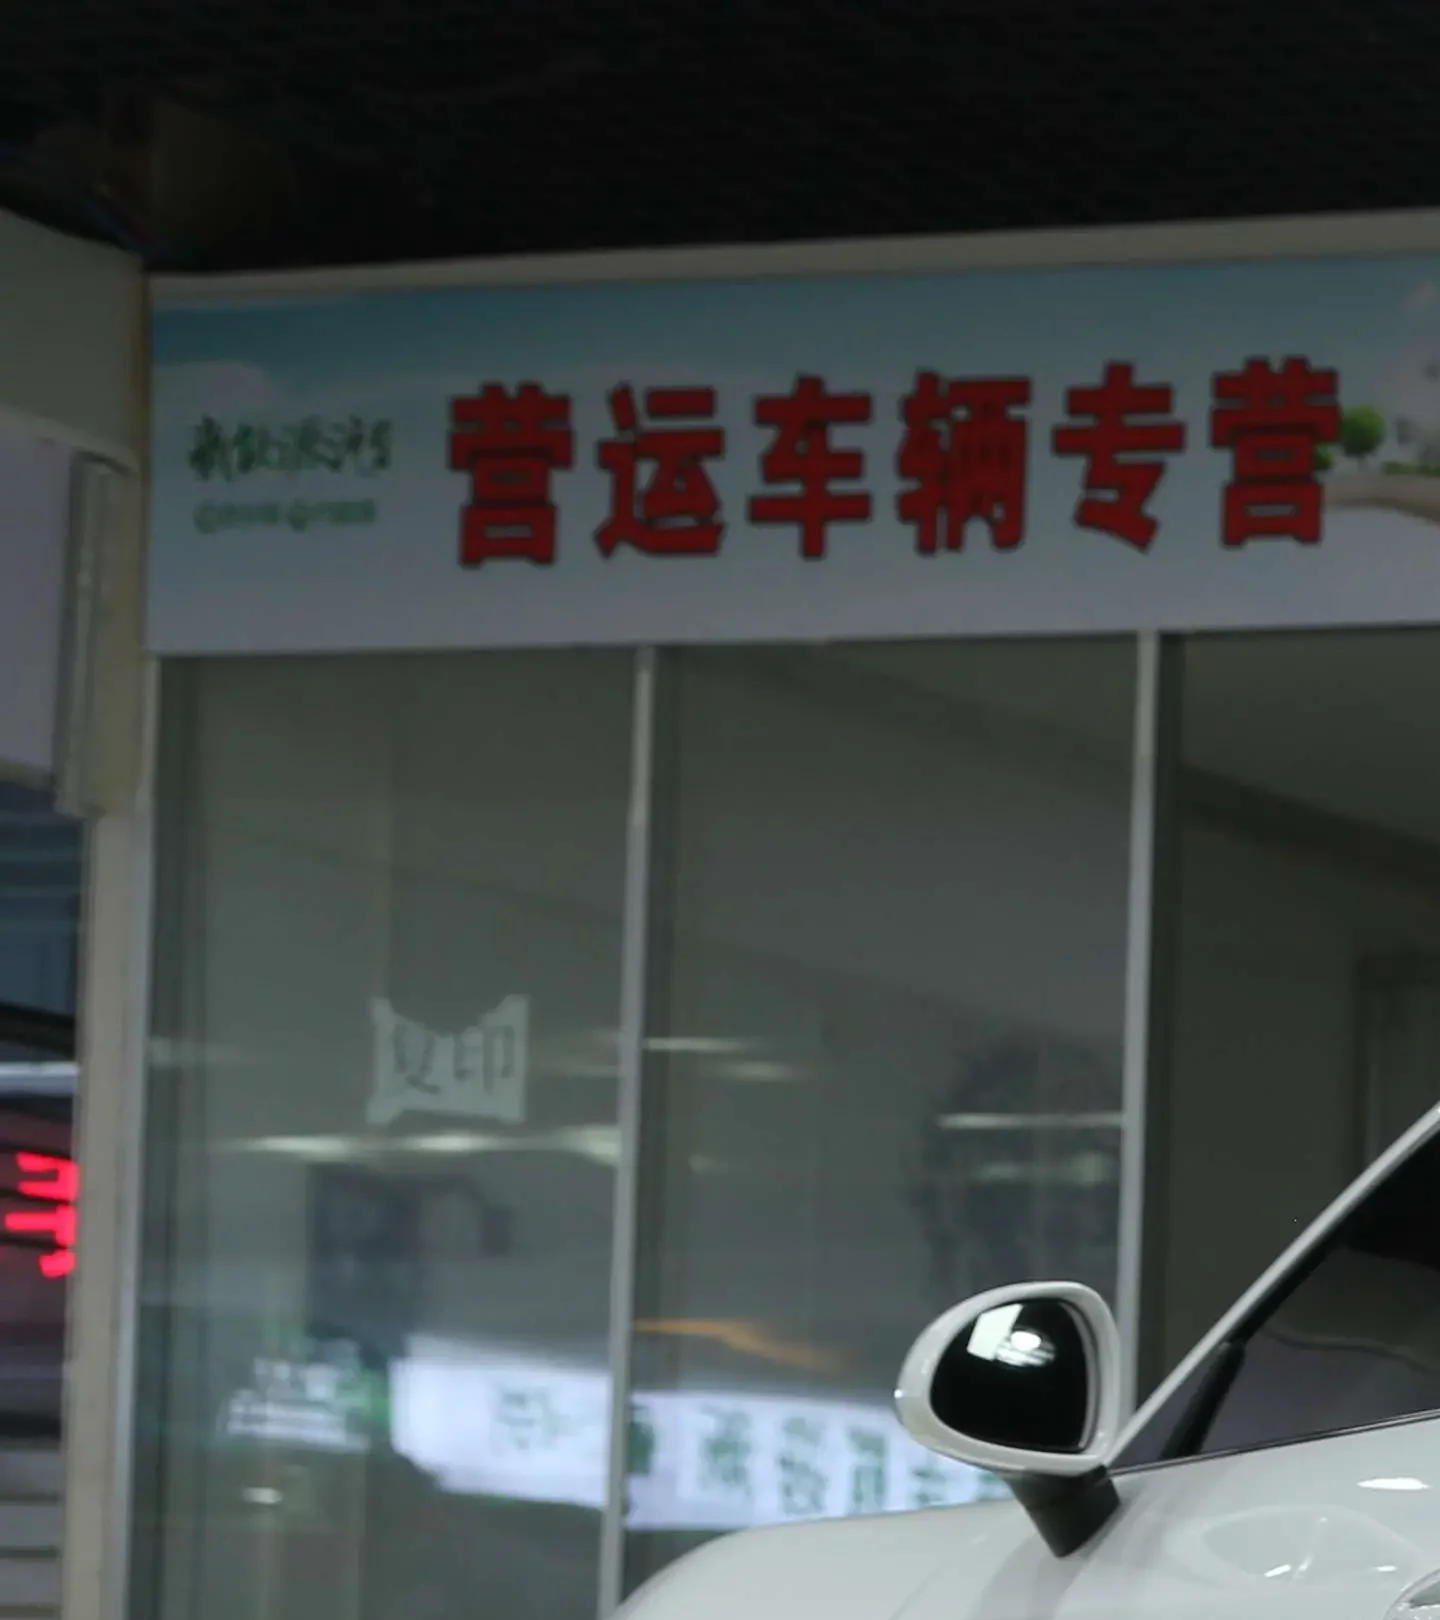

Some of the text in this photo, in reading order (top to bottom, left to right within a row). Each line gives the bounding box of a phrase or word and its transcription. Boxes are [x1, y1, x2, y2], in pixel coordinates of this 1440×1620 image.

[449, 355, 1342, 567] 营运车辆专营
